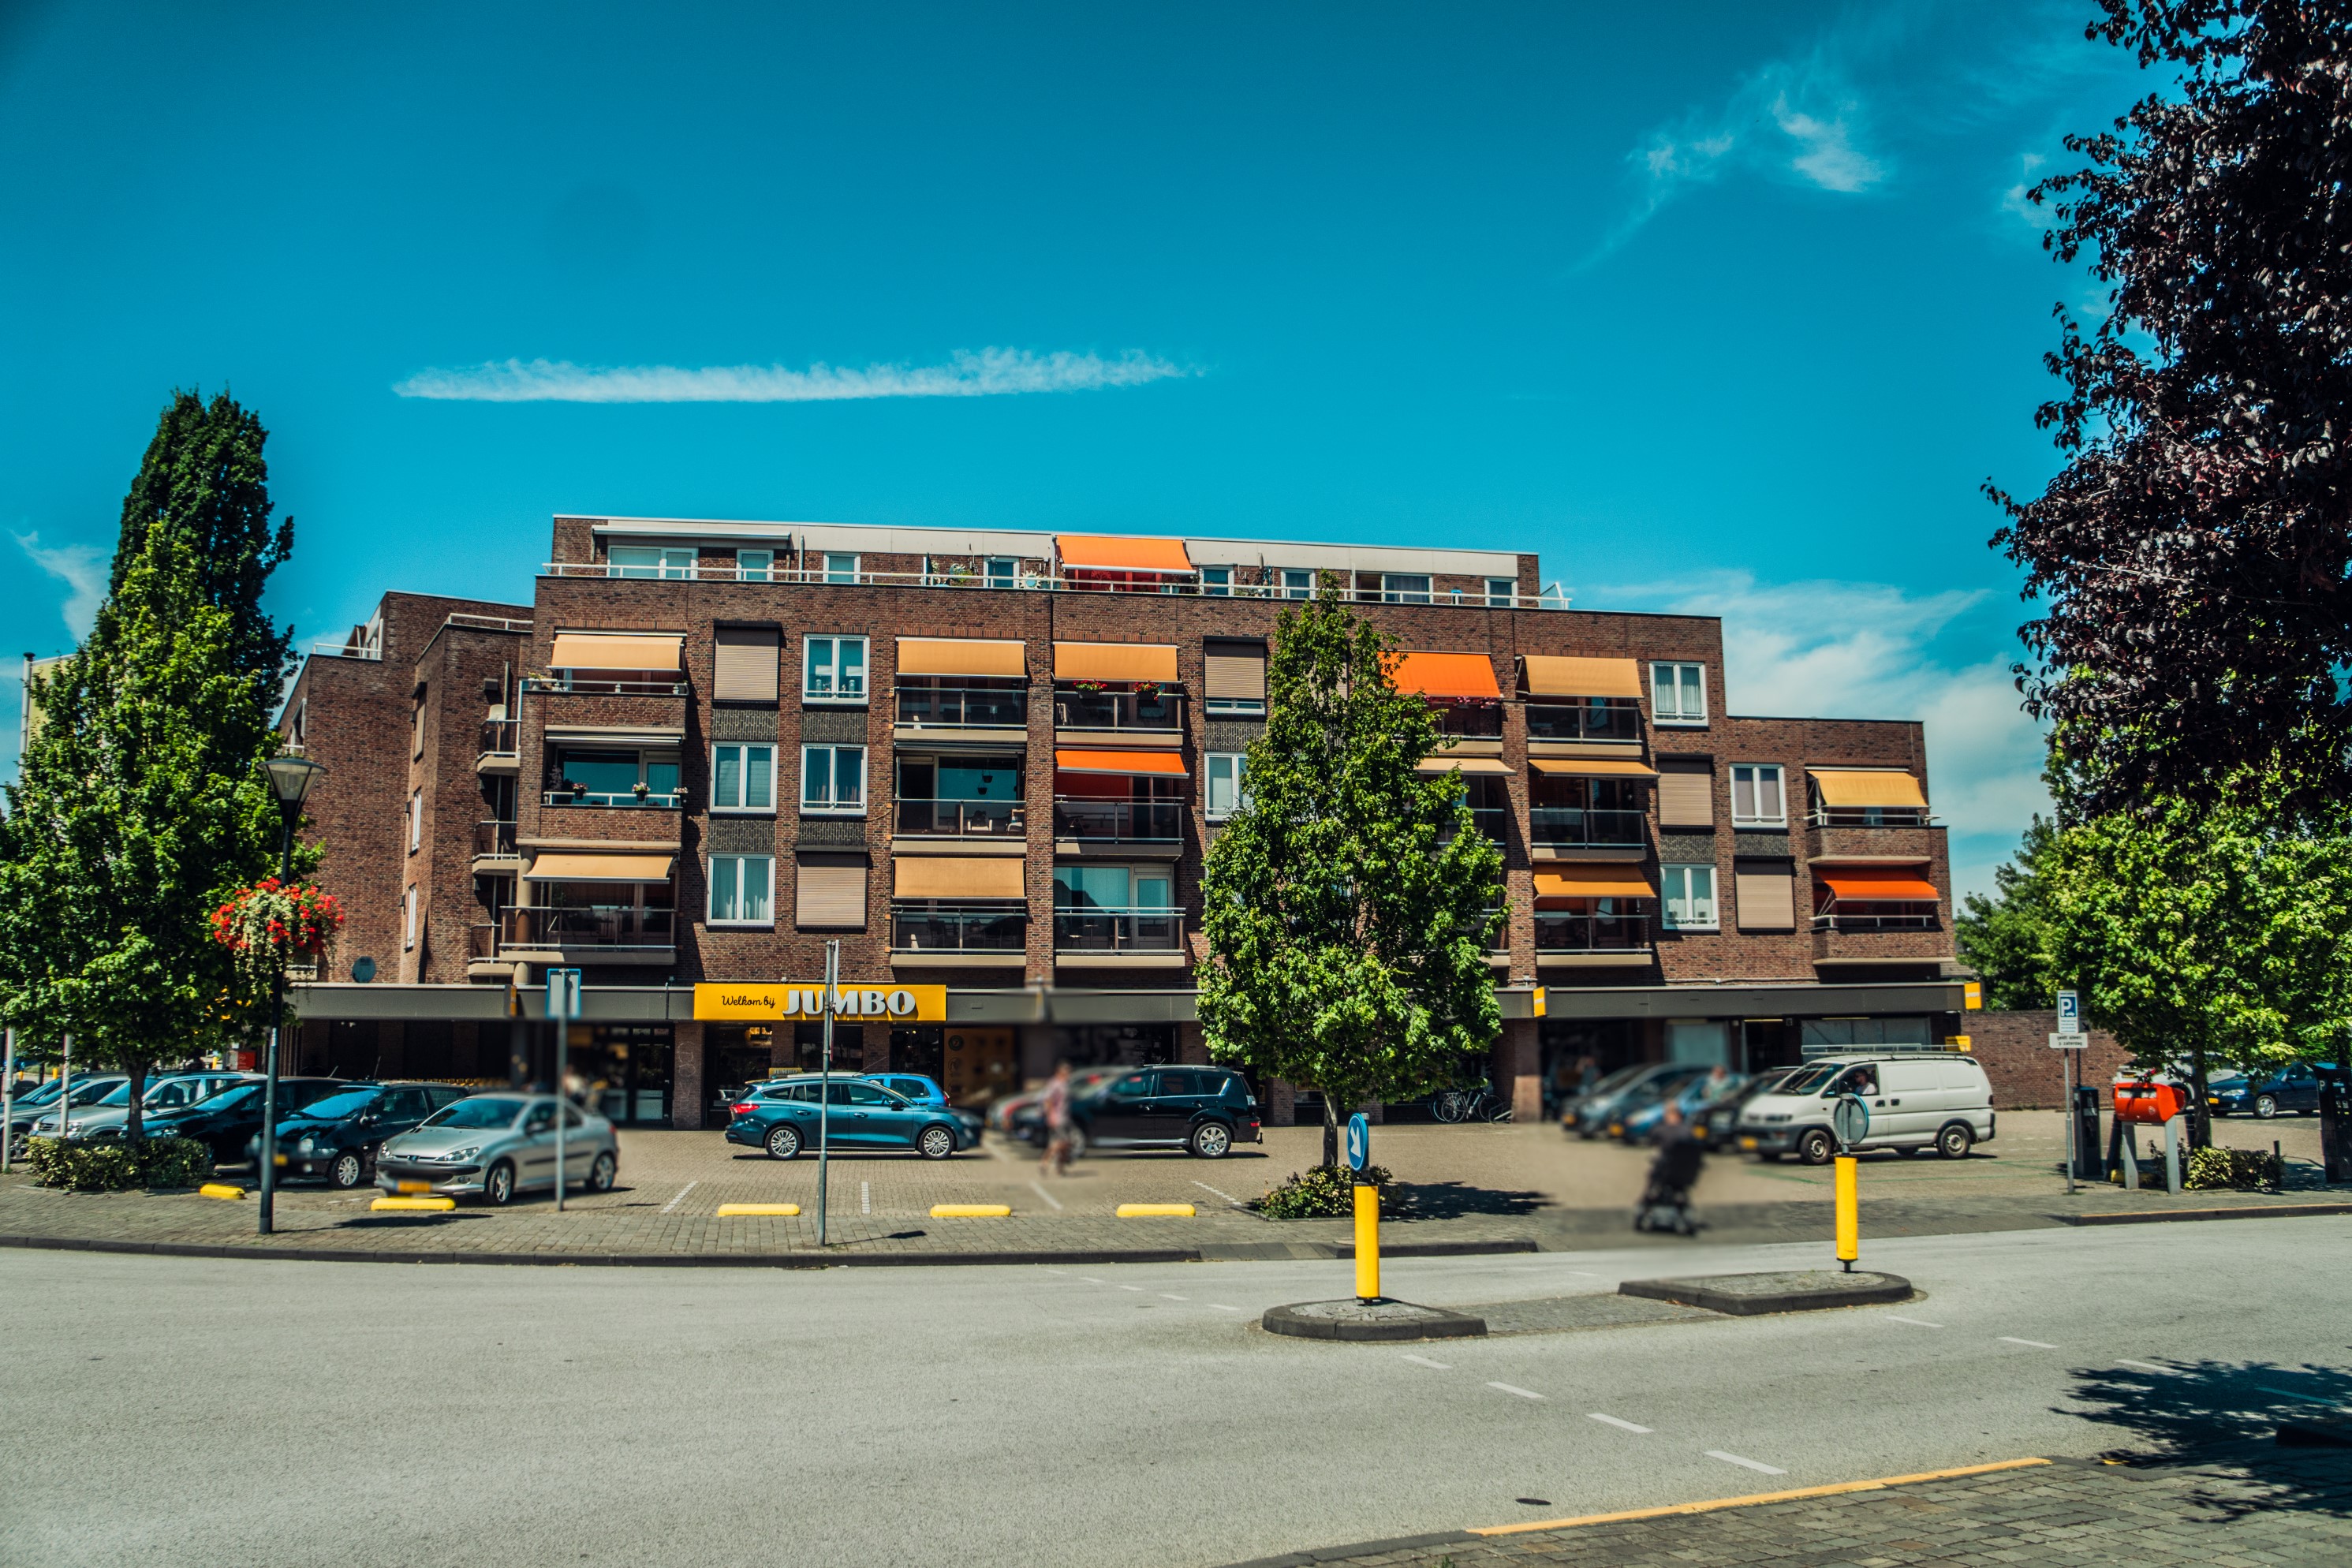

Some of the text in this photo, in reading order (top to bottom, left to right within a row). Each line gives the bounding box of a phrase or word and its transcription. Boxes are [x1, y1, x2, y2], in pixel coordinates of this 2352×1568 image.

[722, 995, 776, 1009] Welkom bij
[782, 990, 917, 1015] JUMBO
[2061, 999, 2072, 1016] P
